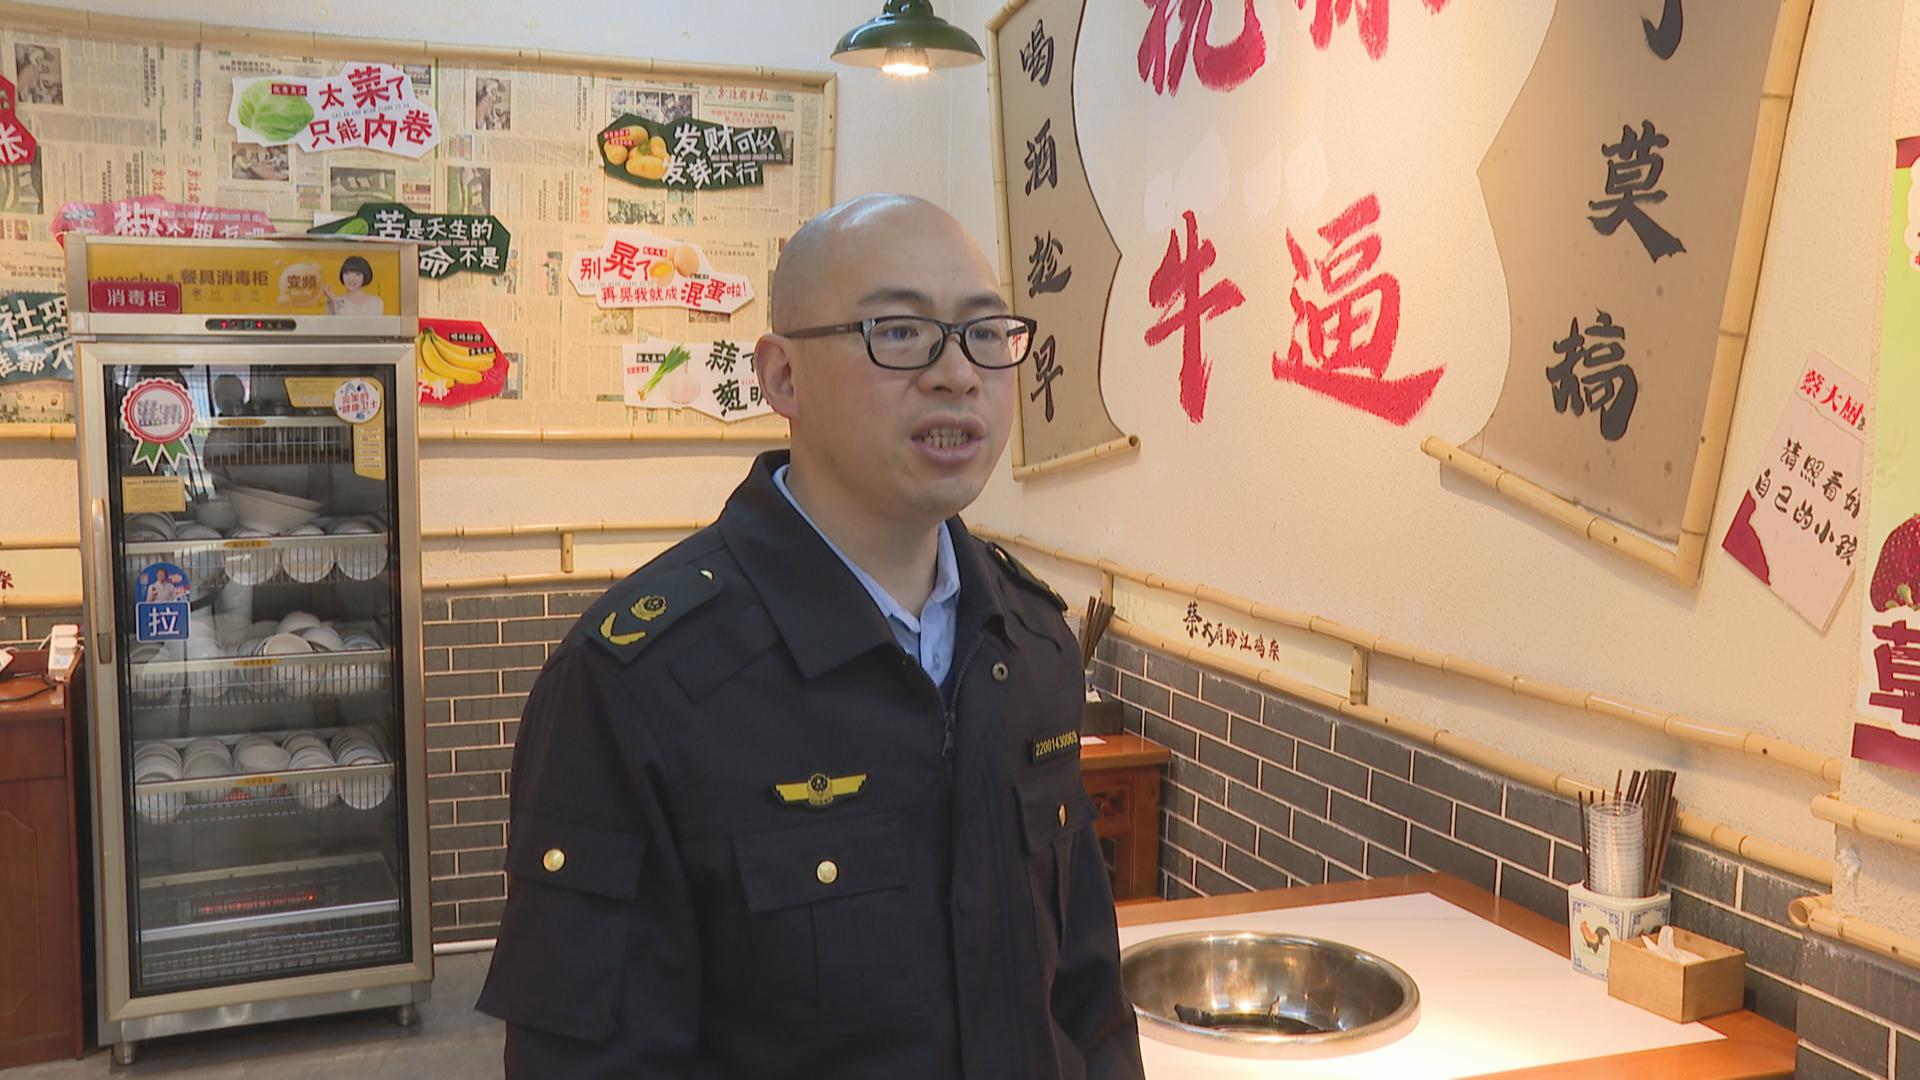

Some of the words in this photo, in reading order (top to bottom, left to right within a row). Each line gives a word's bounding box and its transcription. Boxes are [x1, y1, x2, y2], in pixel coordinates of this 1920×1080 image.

[319, 65, 405, 110] 太菜了
[309, 109, 433, 149] 只能内卷
[674, 123, 776, 158] 发财可以
[374, 210, 493, 240] 苦是天生的
[181, 269, 269, 287] 餐具消毒柜
[419, 246, 500, 278] 命不是
[580, 240, 651, 281] 别晃了
[107, 289, 166, 307] 消毒柜
[1143, 192, 1447, 427] 牛逼
[1755, 468, 1858, 567] 自己的小孩
[148, 607, 180, 637] 拉
